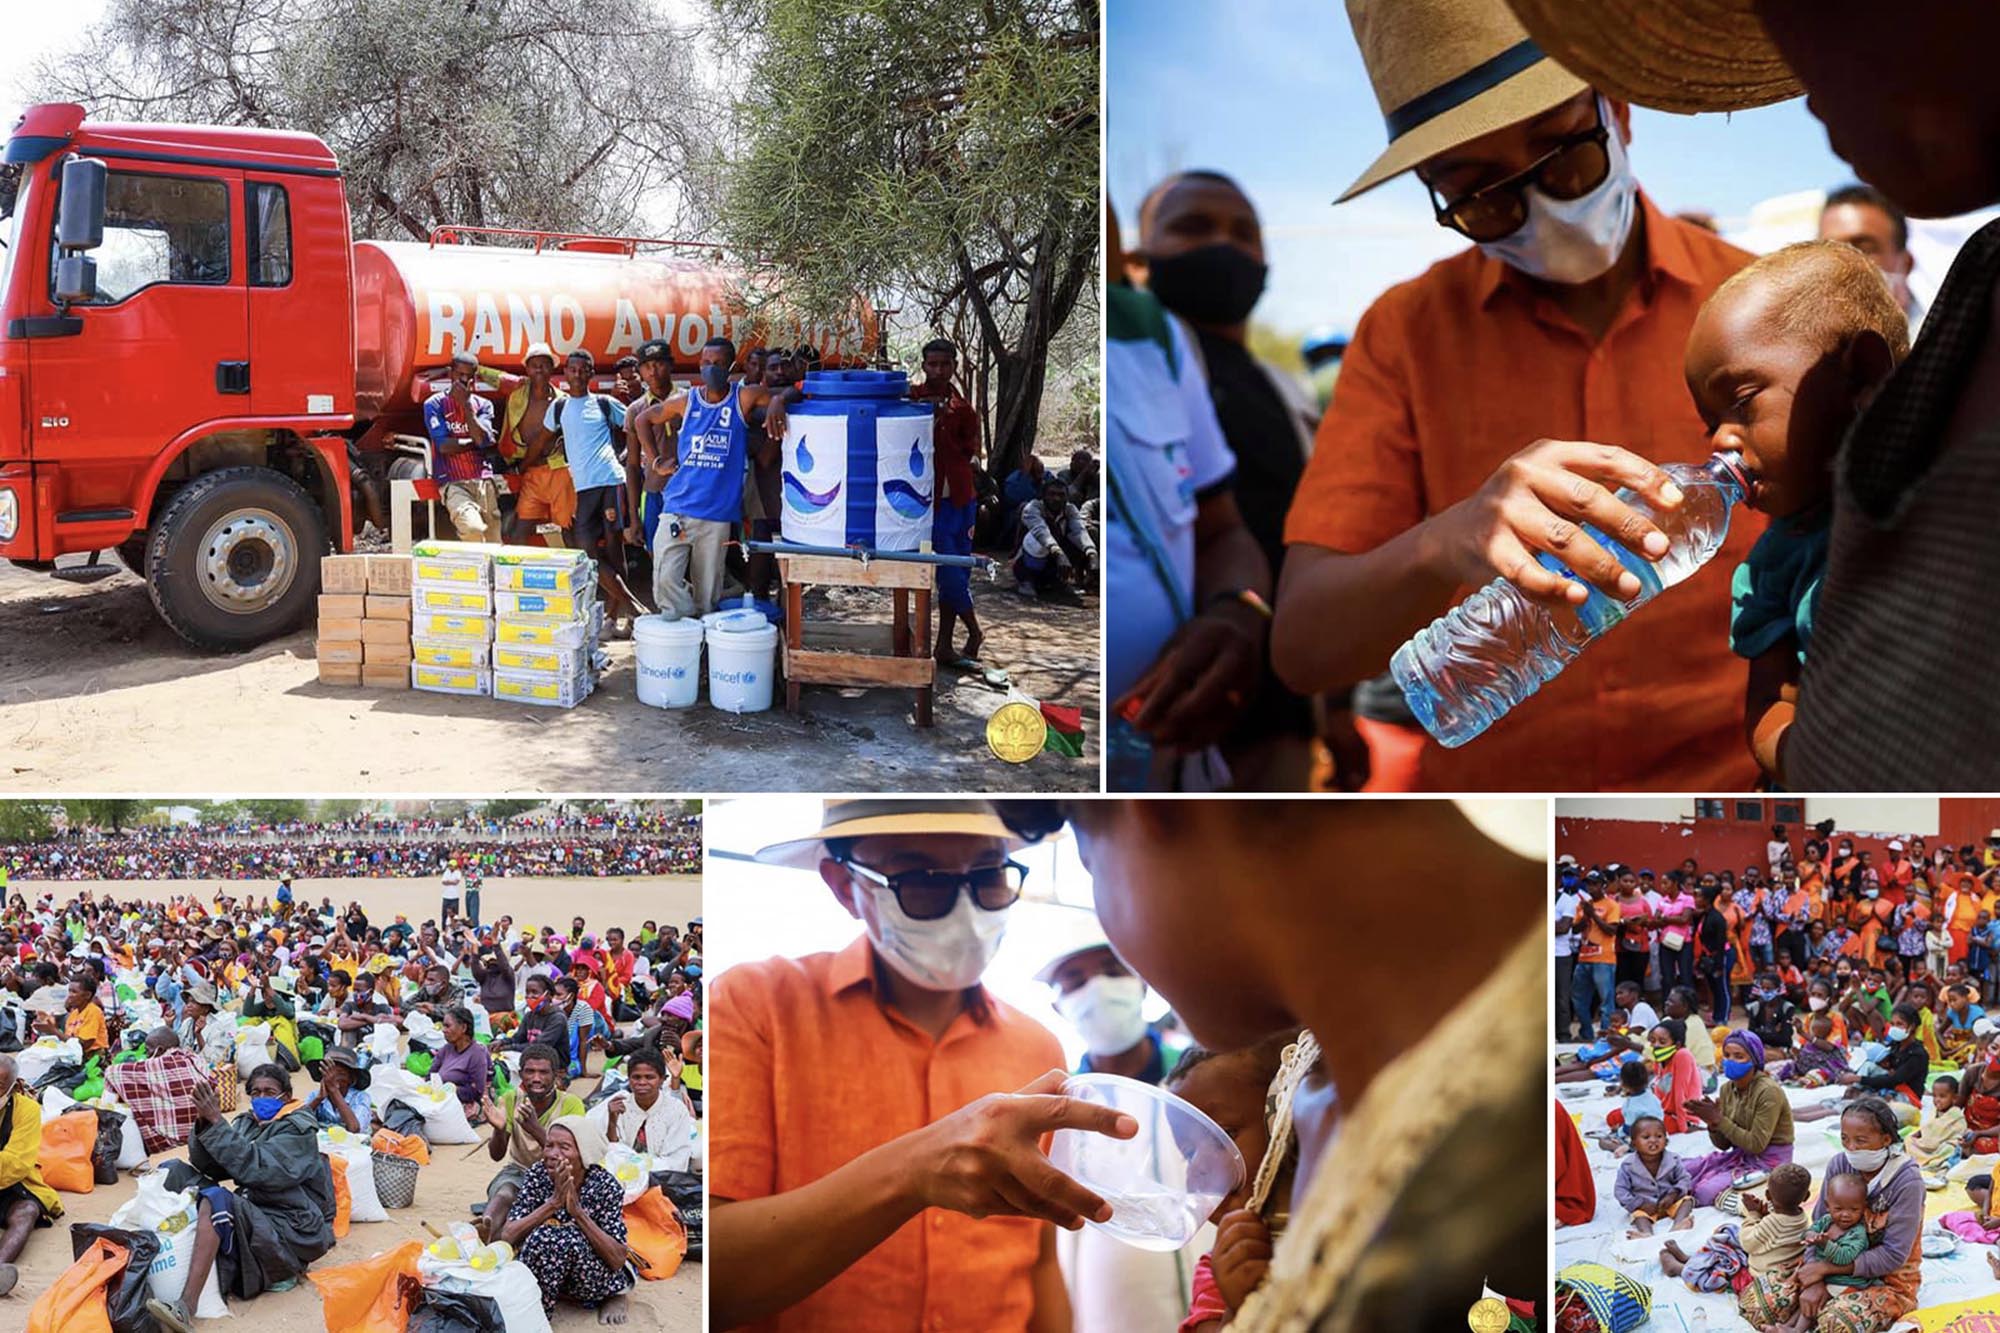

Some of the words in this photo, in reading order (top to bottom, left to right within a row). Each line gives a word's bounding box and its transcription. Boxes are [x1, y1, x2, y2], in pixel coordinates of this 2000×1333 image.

[427, 291, 587, 356] RANO
[719, 406, 731, 428] 9
[640, 667, 671, 680] unicef
[710, 671, 742, 684] unicef
